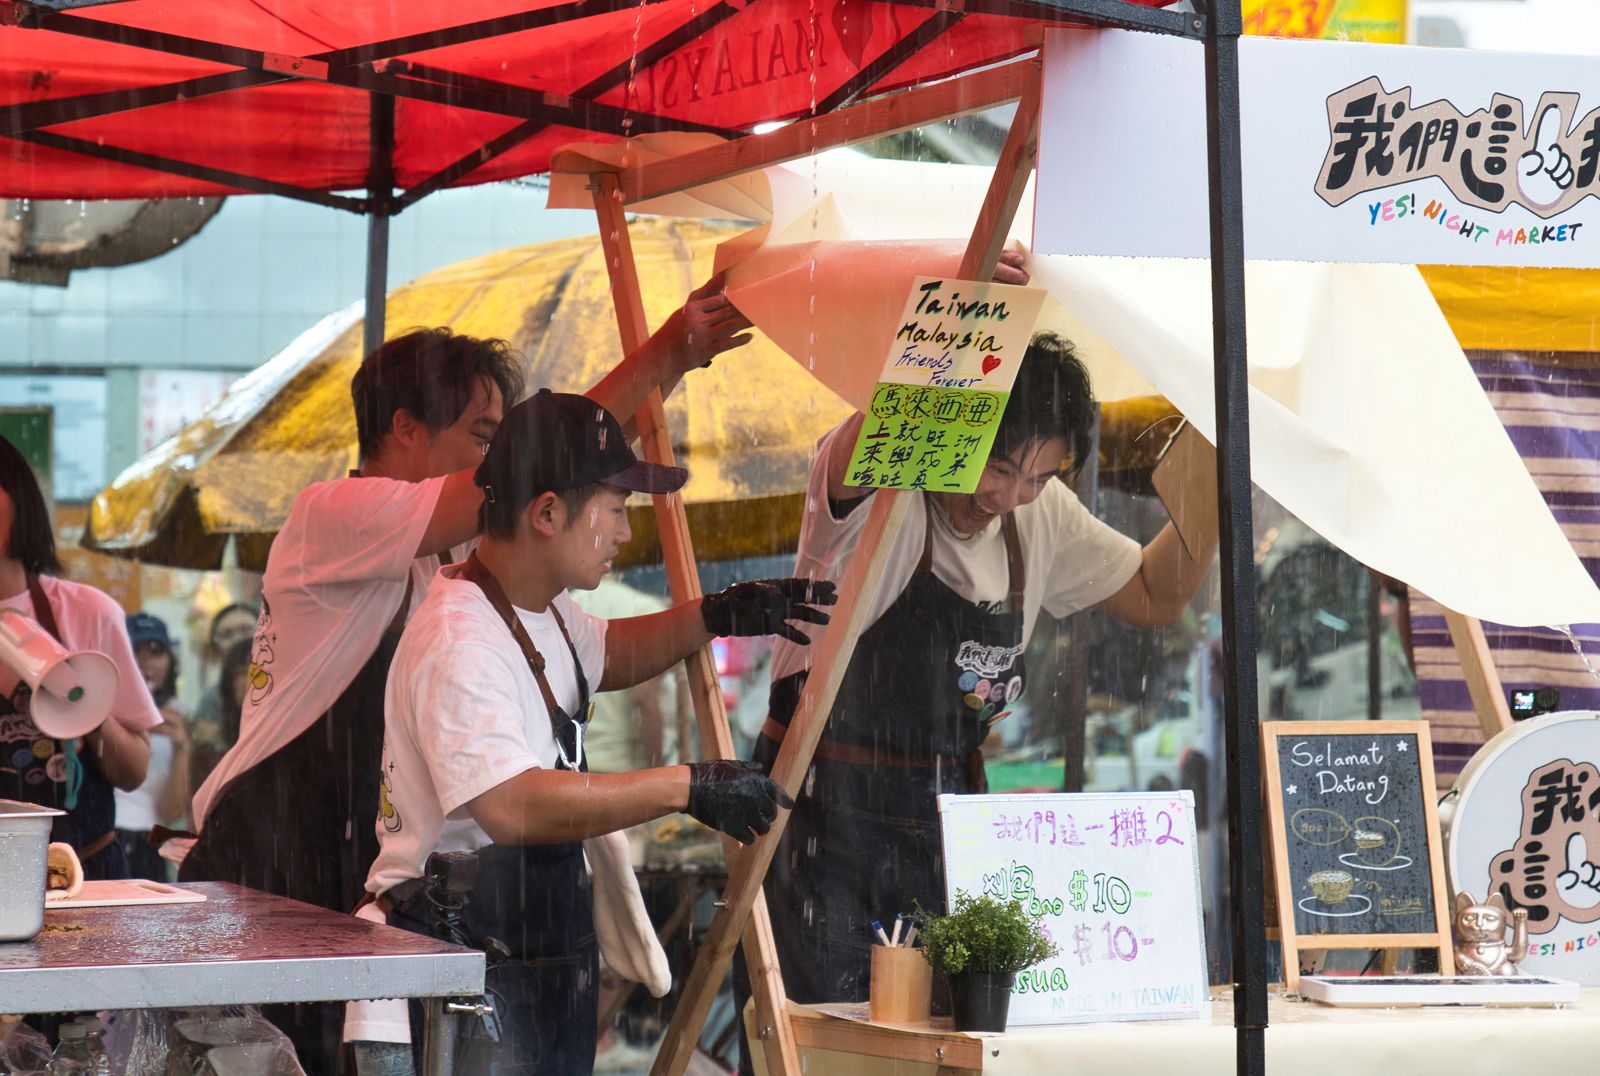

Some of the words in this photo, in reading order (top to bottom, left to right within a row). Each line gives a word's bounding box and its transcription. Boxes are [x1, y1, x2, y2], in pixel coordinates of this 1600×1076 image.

[1368, 193, 1416, 226] YES!
[1423, 199, 1489, 243] NIGHT
[1495, 222, 1583, 246] MARKET
[915, 280, 1010, 321] Taiwan
[896, 321, 1003, 352] Malaysia
[894, 345, 953, 369] Friends
[927, 370, 983, 388] Forever
[1291, 741, 1384, 767] Selamat
[1316, 770, 1389, 805] Datang
[1531, 767, 1600, 836] 我
[1528, 943, 1556, 956] ES!
[1564, 932, 1600, 953] NIG
[1009, 967, 1069, 994] sua
